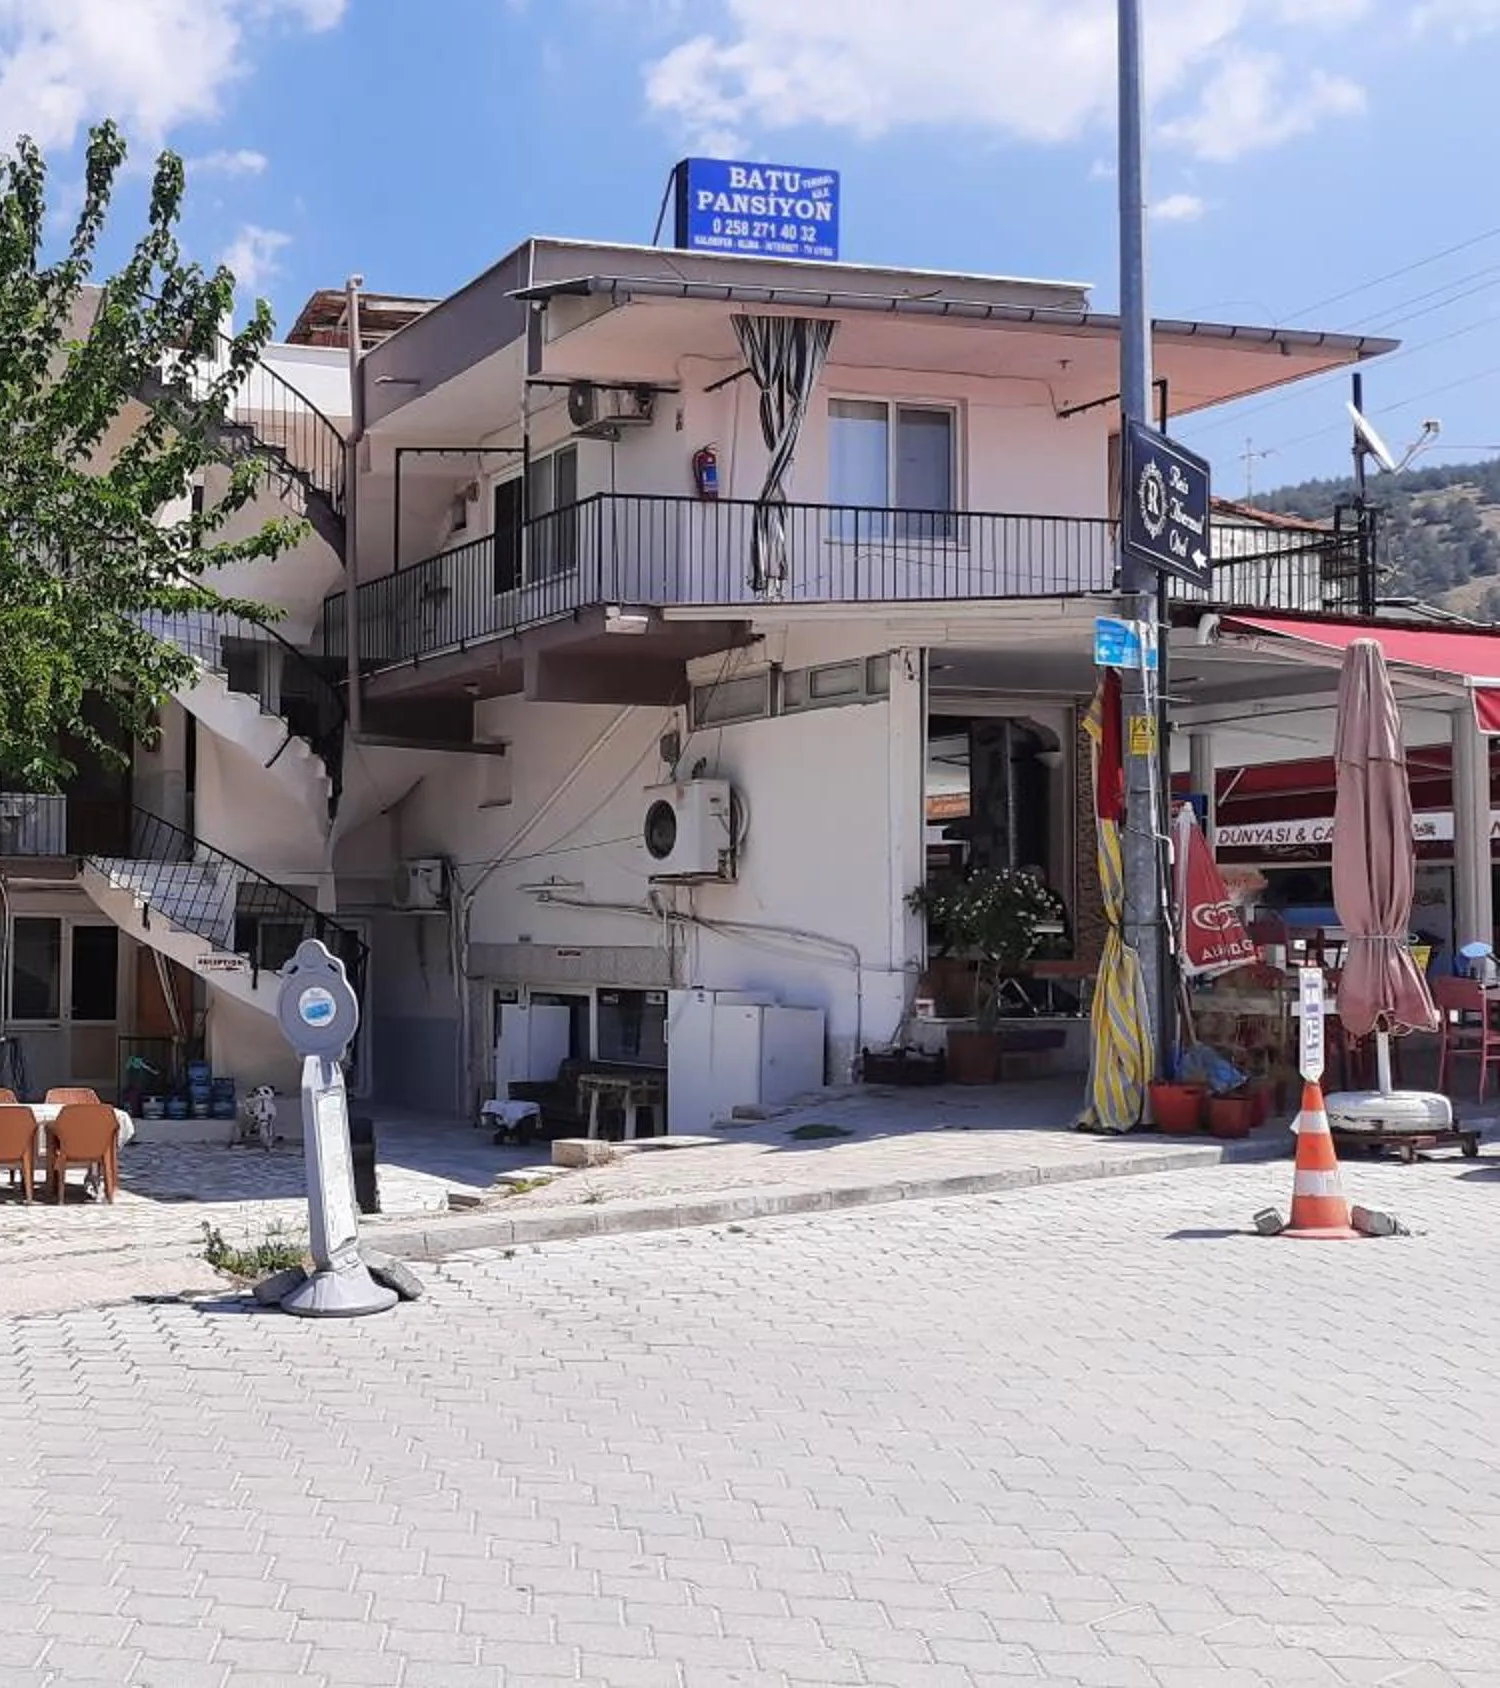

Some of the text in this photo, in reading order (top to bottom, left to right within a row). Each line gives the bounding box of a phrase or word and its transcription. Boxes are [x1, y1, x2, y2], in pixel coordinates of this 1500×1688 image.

[729, 167, 801, 193] BATU
[697, 190, 833, 222] PANSİYON
[712, 218, 817, 243] 0 258 271 40 32
